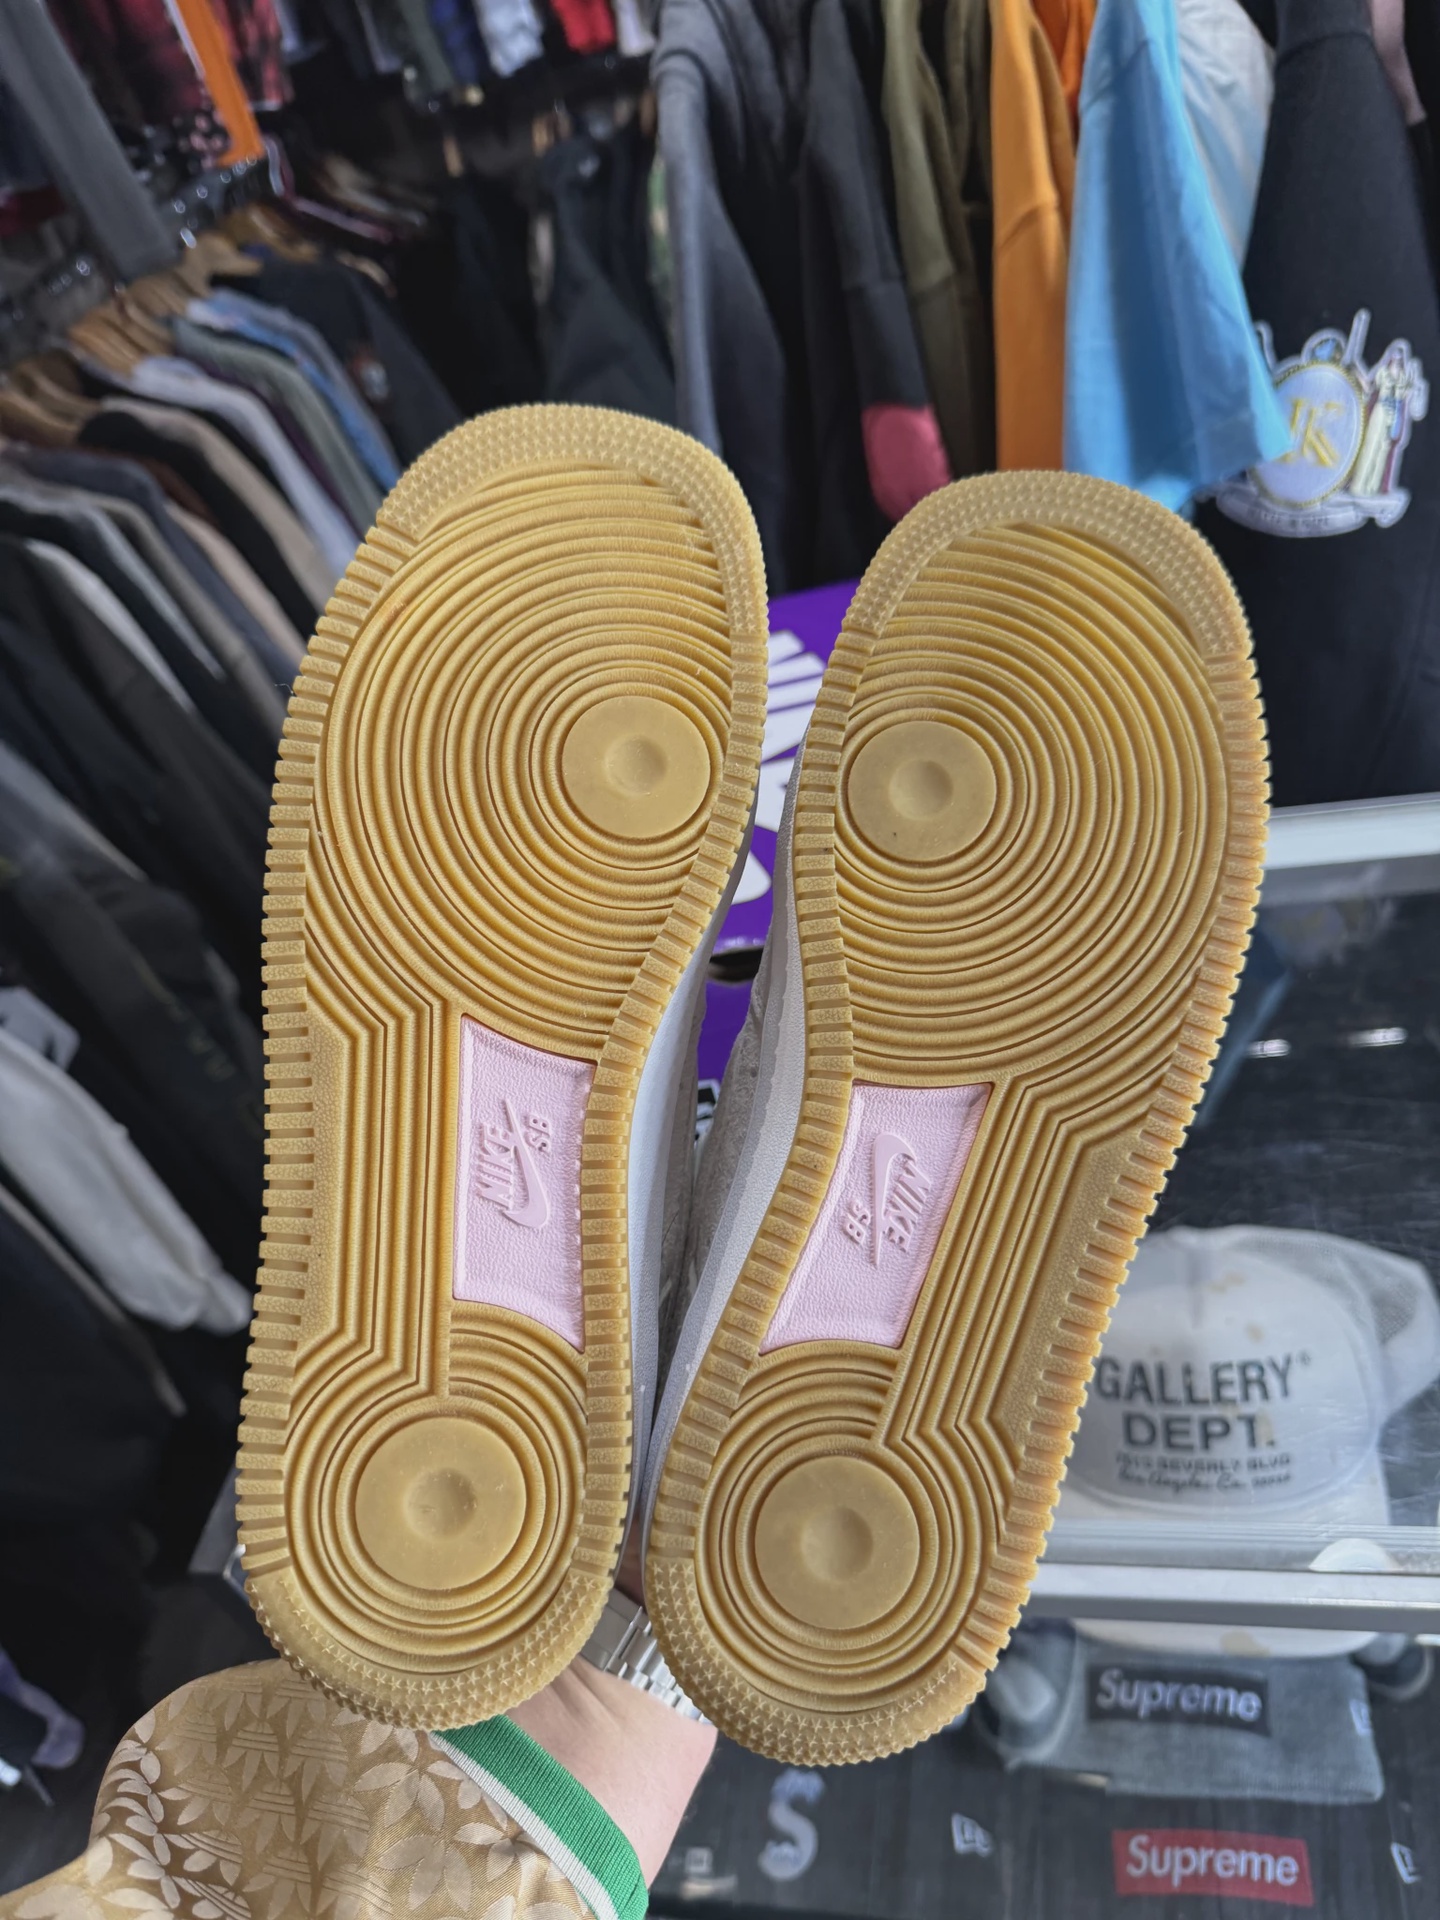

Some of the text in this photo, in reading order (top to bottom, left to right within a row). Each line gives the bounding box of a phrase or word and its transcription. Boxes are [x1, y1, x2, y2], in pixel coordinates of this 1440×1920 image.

[523, 1112, 552, 1152] SB
[474, 1122, 516, 1211] NIKE
[842, 1198, 872, 1247] SB
[884, 1159, 932, 1253] NIKE
[1096, 1354, 1292, 1406] GALLERY
[1124, 1412, 1275, 1450] DEPT.
[1097, 1667, 1263, 1722] Supreme
[1126, 1833, 1300, 1888] Supreme
